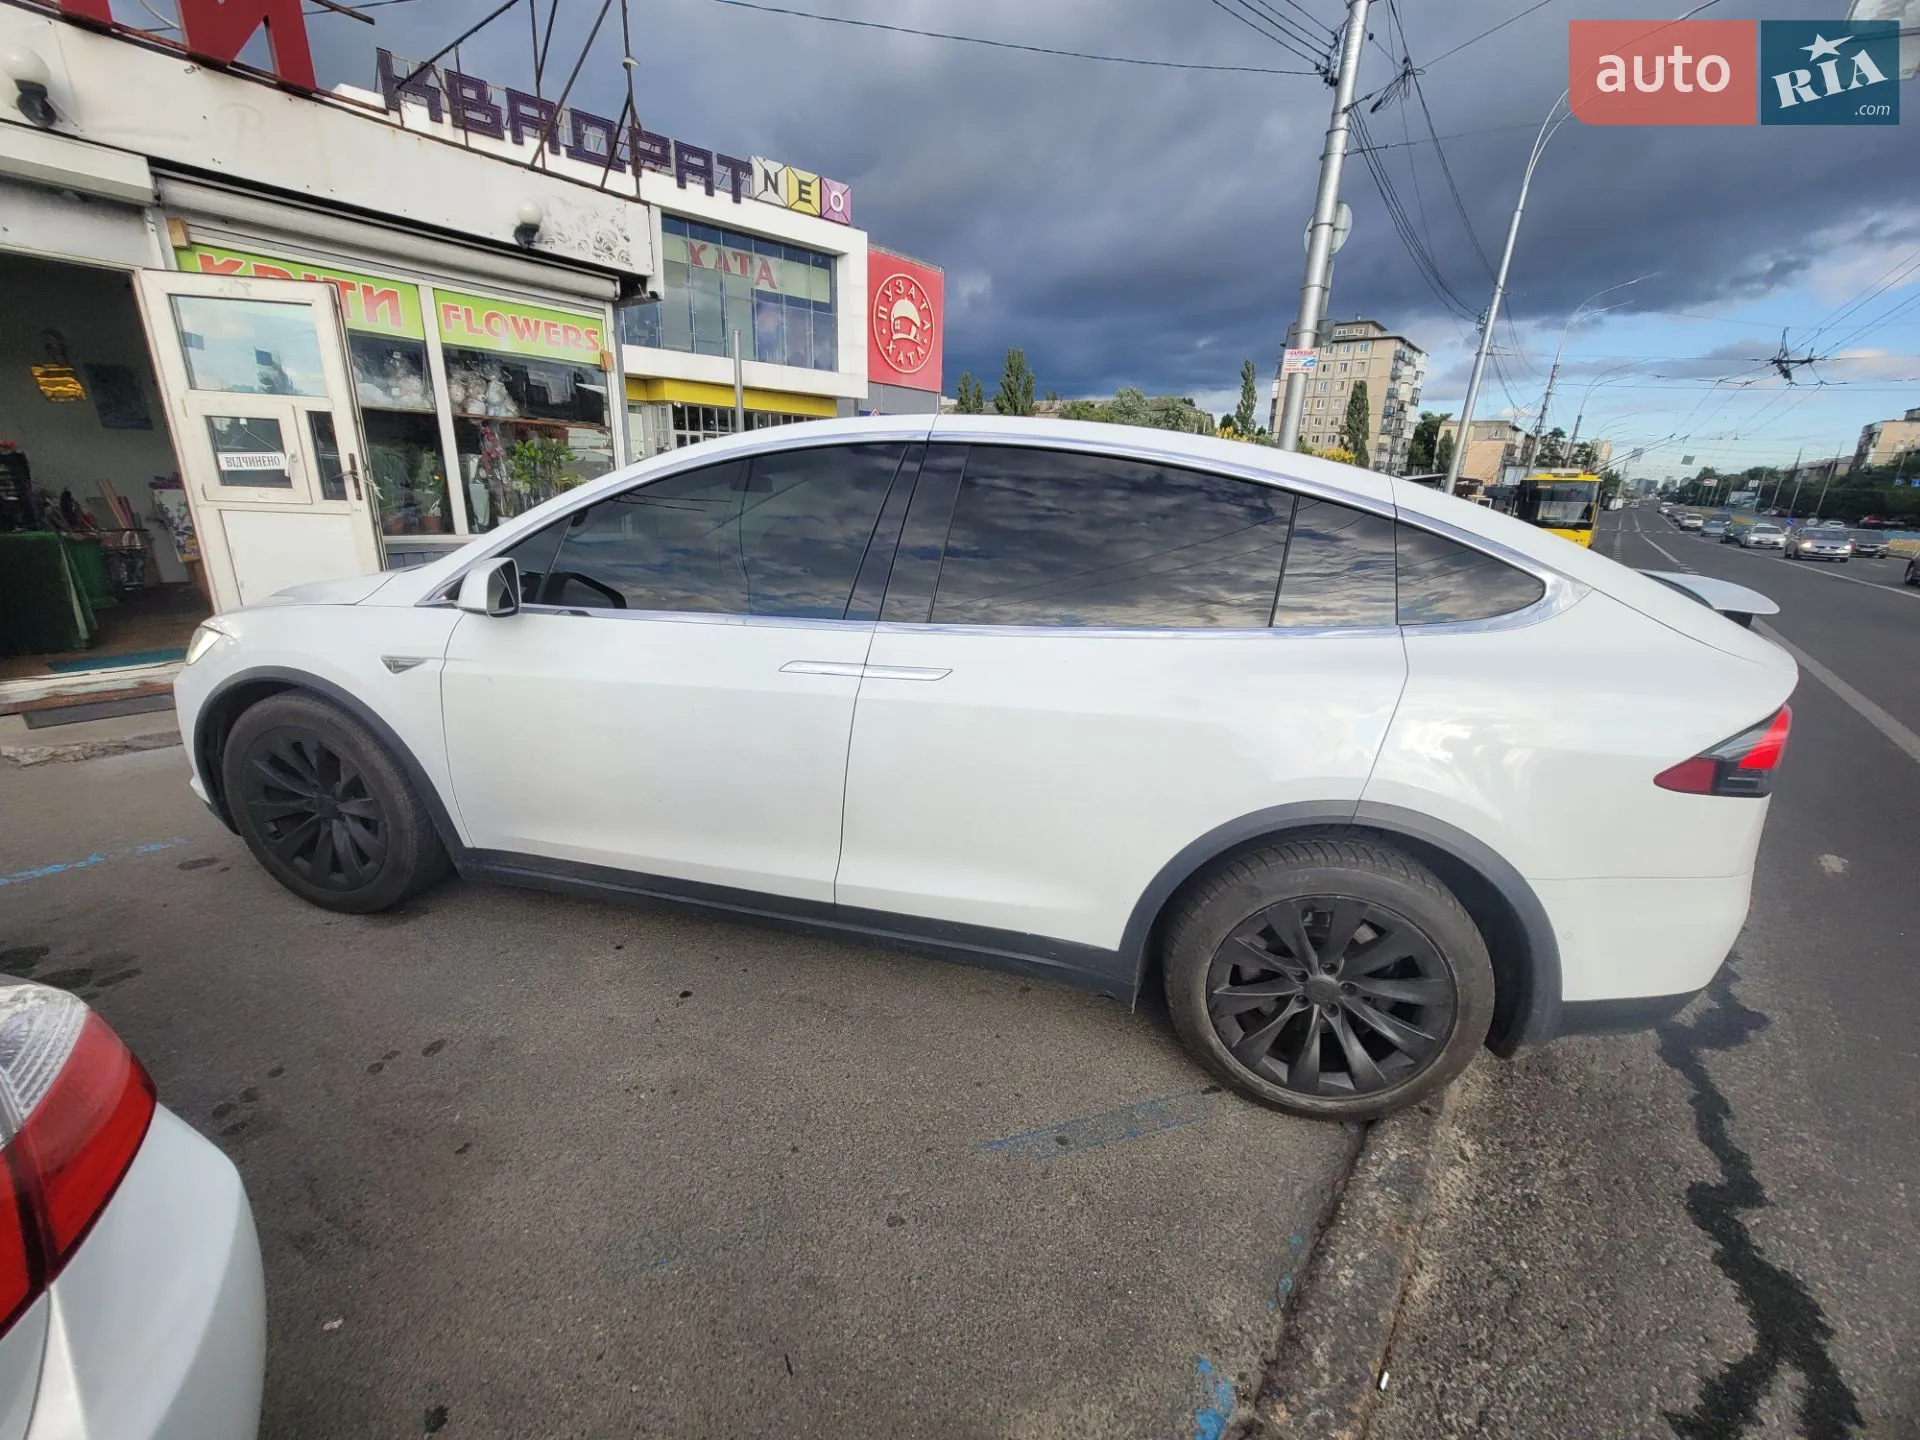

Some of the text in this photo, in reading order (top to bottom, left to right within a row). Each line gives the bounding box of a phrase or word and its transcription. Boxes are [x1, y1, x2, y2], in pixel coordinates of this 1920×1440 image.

[376, 47, 844, 212] КВАДРАТ NEO
[441, 303, 601, 352] FLOWERS
[877, 279, 931, 331] ПУЗАТА
[886, 339, 926, 366] ХАТА
[225, 455, 281, 468] ВІДЧИНЕНО
